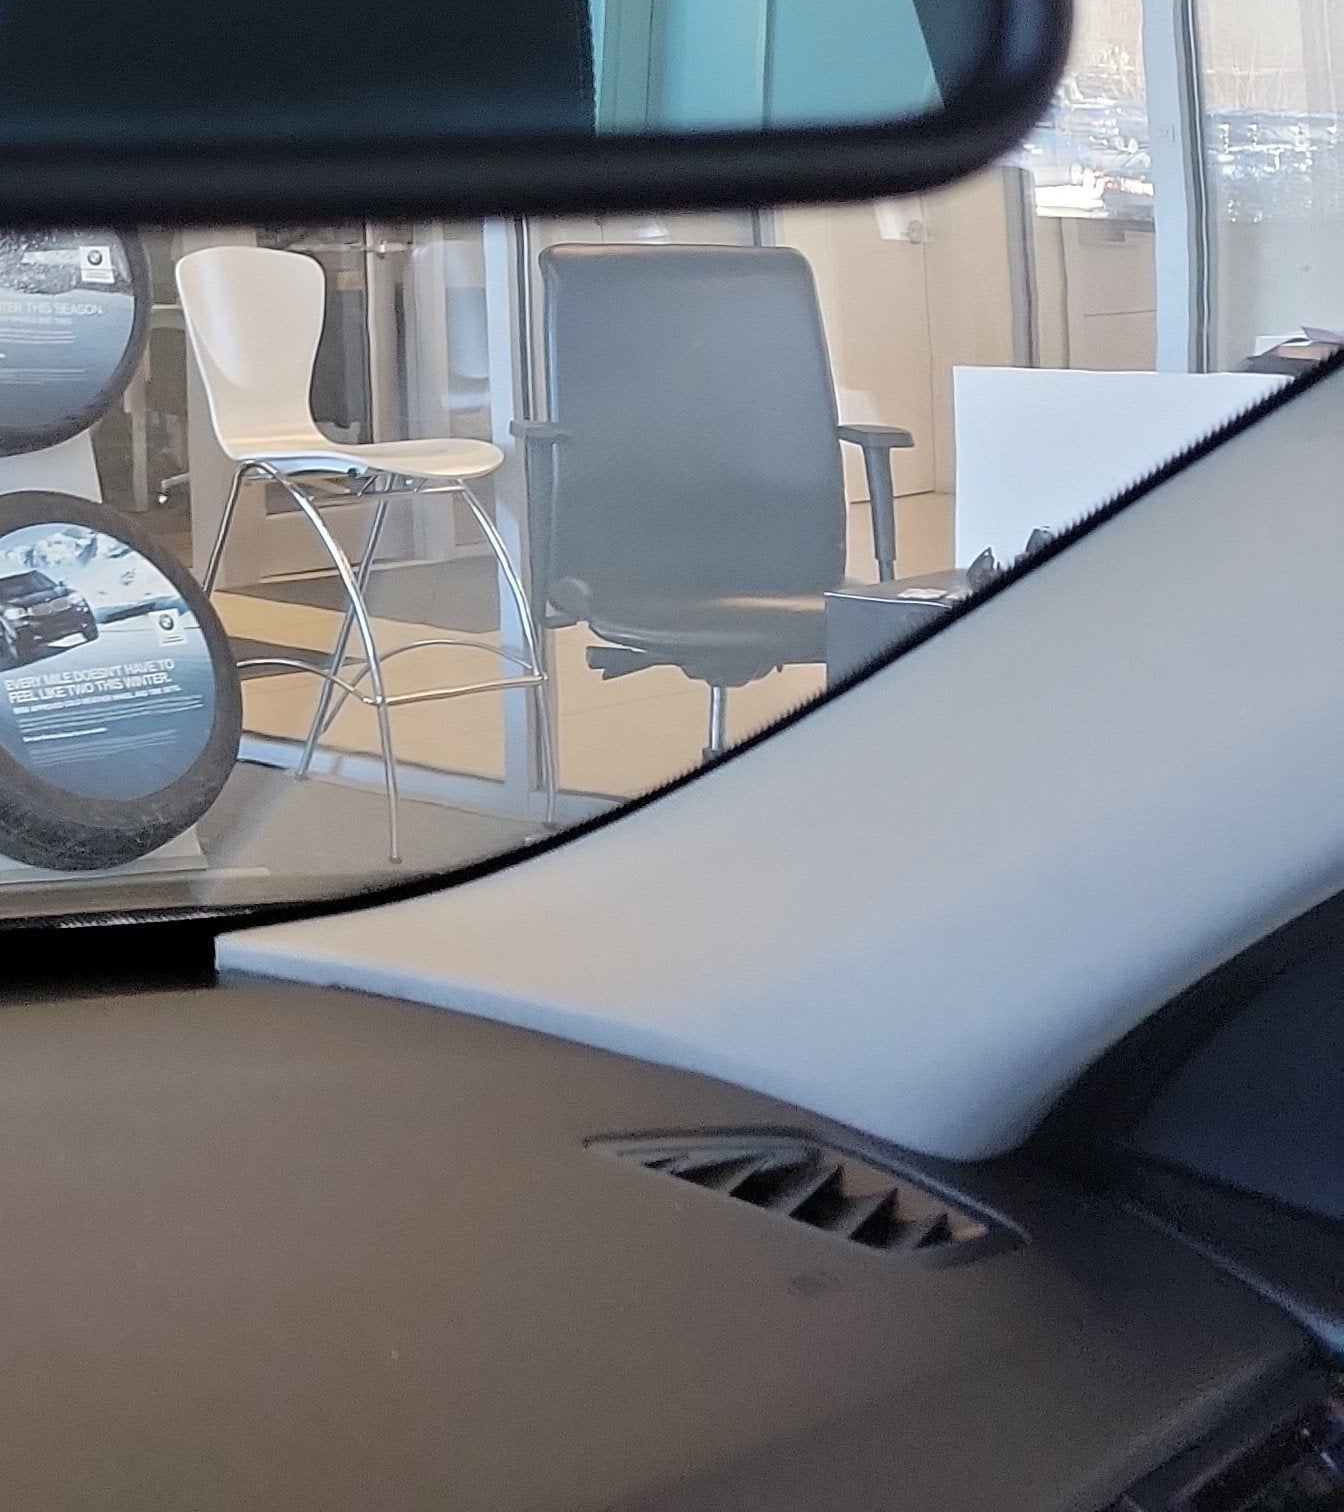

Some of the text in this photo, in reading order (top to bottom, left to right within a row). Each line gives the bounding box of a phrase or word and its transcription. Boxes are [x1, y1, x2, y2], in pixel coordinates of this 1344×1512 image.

[5, 675, 41, 691] EVERY
[45, 671, 73, 686] MILE
[125, 660, 159, 676] HAVE
[159, 658, 175, 670] TO
[8, 689, 39, 704] FEEL
[39, 685, 67, 701] LIKE
[67, 681, 95, 697] TWO
[95, 677, 123, 693] THIS
